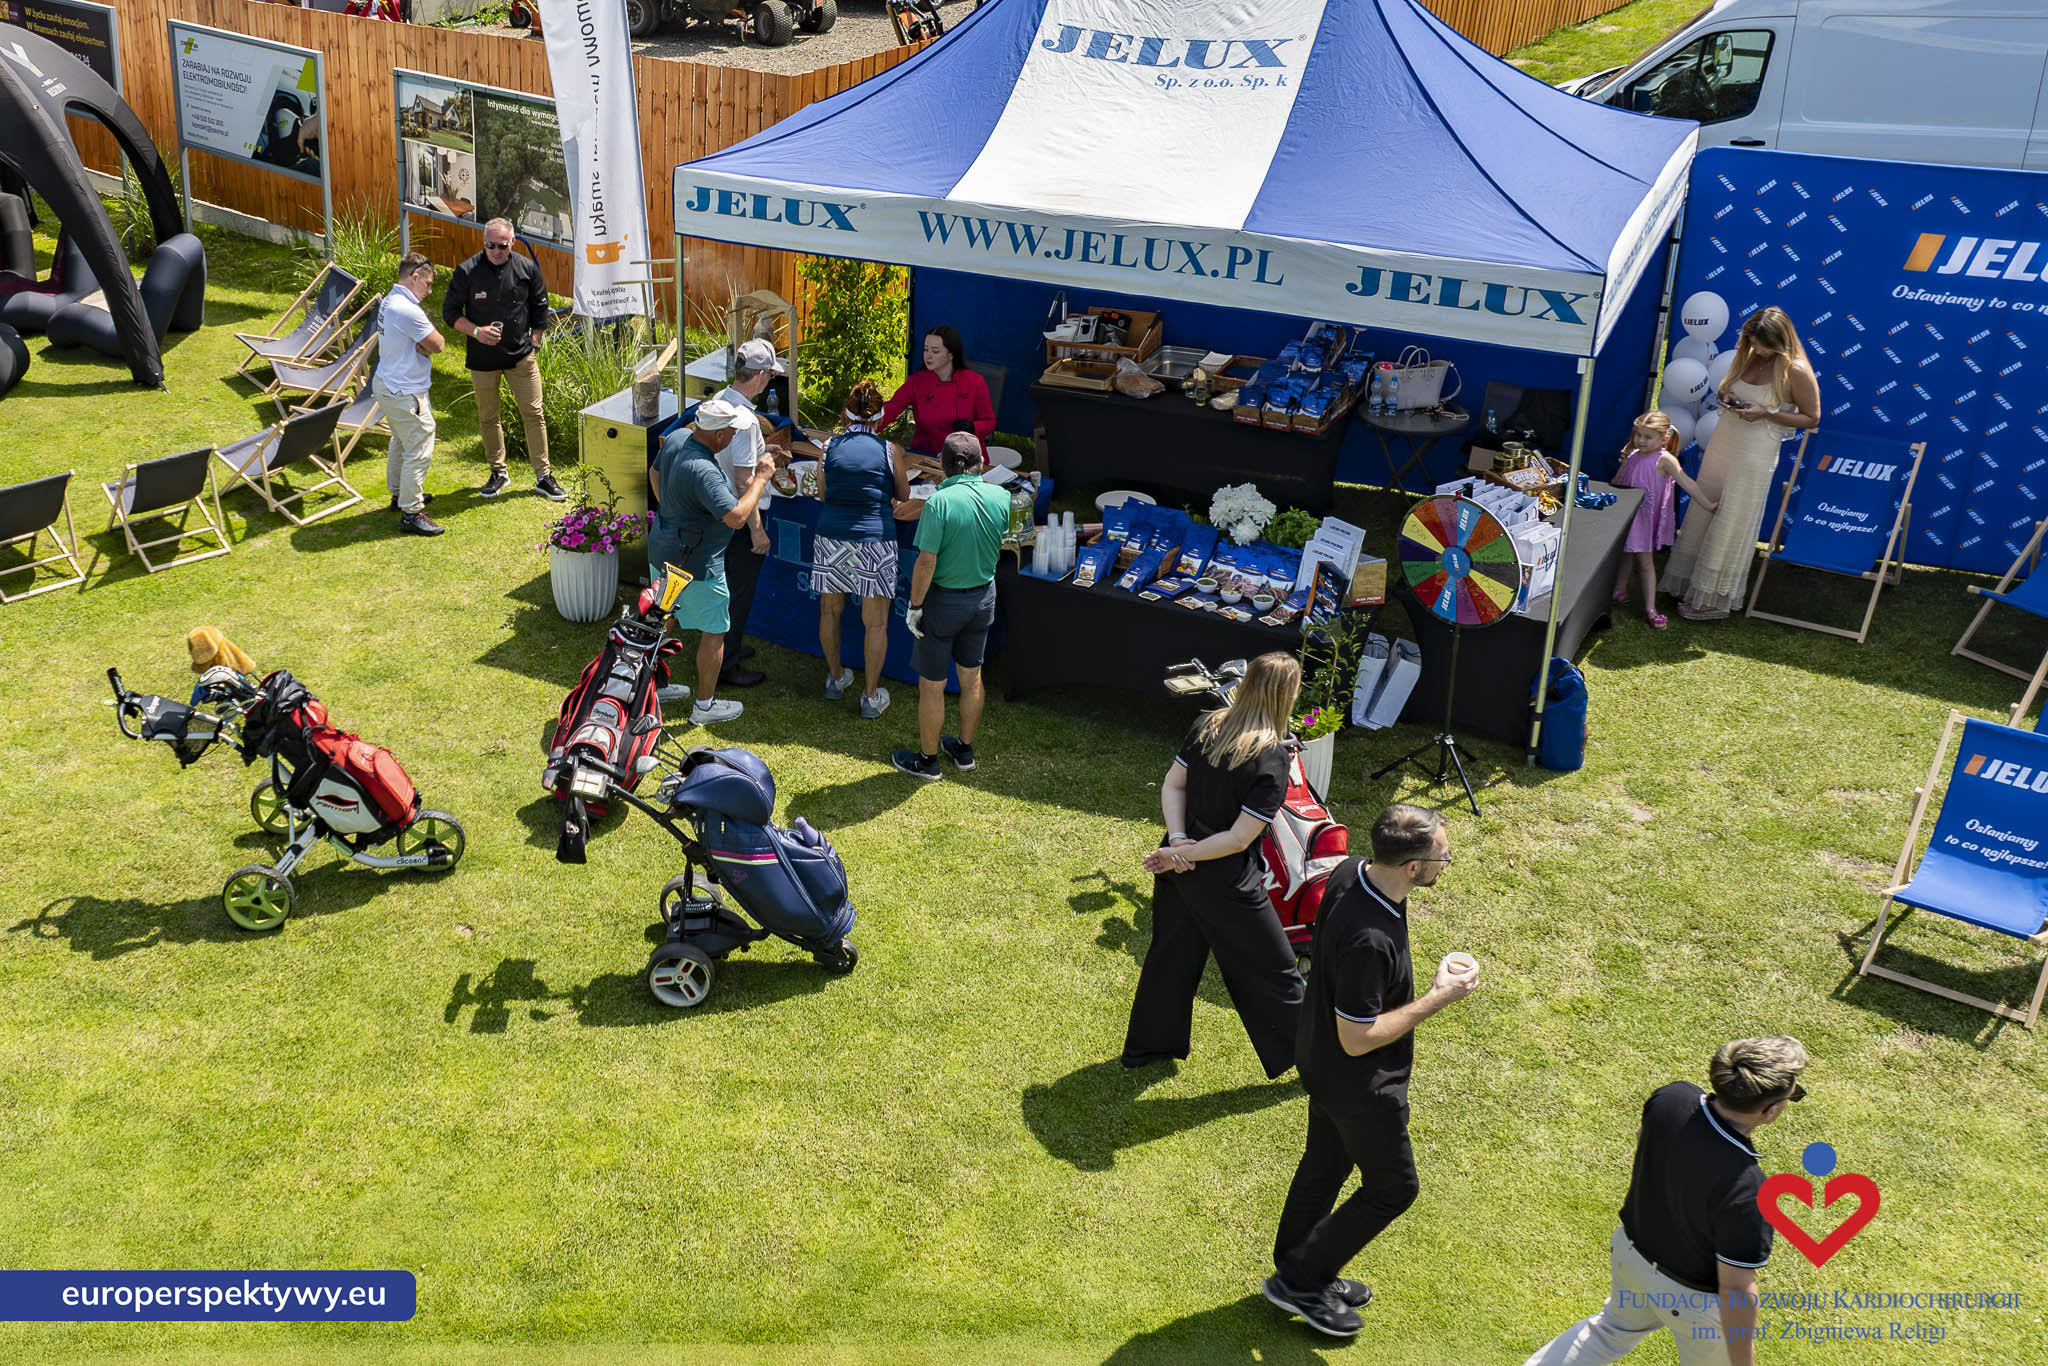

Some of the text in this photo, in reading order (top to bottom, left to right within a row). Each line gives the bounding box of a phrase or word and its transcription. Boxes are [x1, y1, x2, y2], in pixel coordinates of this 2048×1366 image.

[182, 59, 252, 84] ZARABIAJ NA ROZWOJU
[1188, 78, 1198, 88] z
[1276, 74, 1288, 87] k
[487, 98, 519, 113] Intymność
[520, 106, 531, 116] dla
[1720, 177, 1736, 191] JELUX
[1759, 179, 1777, 194] JELUX
[1794, 184, 1810, 199] JELUX
[1835, 186, 1853, 201] JELUX
[1870, 190, 1888, 206] JELUX
[1914, 194, 1934, 210] JELUX
[1952, 199, 1970, 214] JELUX
[1999, 200, 2019, 215] JELUX
[1717, 204, 1733, 218] JELUX
[1755, 210, 1771, 224] JELUX
[1790, 212, 1807, 226] JELUX
[1830, 215, 1847, 232] JELUX
[917, 210, 1286, 287] WWW.JELUX.PL
[1712, 240, 1727, 253] JELUX
[1751, 242, 1768, 255] JELUX
[1784, 248, 1800, 261] JELUX
[1825, 250, 1842, 264] JELUX
[1936, 236, 2048, 284] JEL
[1708, 265, 1726, 279] JELUX
[1746, 272, 1762, 286] JELUX
[1780, 273, 1798, 287] JELUX
[1820, 280, 1836, 294] JELUX
[1892, 284, 1985, 312] Osłaniamy
[1988, 297, 2008, 309] to
[2011, 302, 2035, 312] co
[1687, 318, 1709, 326] JELUX
[1815, 312, 1832, 324] JELUX
[1849, 317, 1865, 331] JELUX
[1891, 321, 1909, 334] JELUX
[1927, 324, 1944, 340] JELUX
[1971, 329, 1990, 343] JELUX
[2009, 335, 2026, 349] JELUX
[1810, 339, 1826, 354] JELUX
[1842, 344, 1861, 357] JELUX
[1886, 350, 1902, 364] JELUX
[1919, 353, 1940, 366] JELUX
[1964, 359, 1982, 373] JELUX
[2003, 362, 2022, 375] JELUX
[1838, 375, 1854, 390] JELUX
[1880, 381, 1897, 393] JELUX
[1915, 384, 1931, 400] JELUX
[1957, 390, 1977, 404] JELUX
[1834, 402, 1850, 414] JELUX
[1995, 396, 2012, 410] JELUX
[1874, 409, 1890, 422] JELUX
[1909, 412, 1927, 424] JELUX
[1952, 419, 1968, 432] JELUX
[1989, 422, 2008, 434] JELUX
[1828, 457, 1898, 482] JELUX
[1817, 502, 1869, 522] Osłaniamy
[1459, 508, 1470, 531] JELUX
[1803, 514, 1879, 533] to co najlepsze!
[1441, 589, 1452, 612] JELUX
[1965, 818, 2040, 851] Osłaniamy
[1944, 834, 1960, 844] to
[1961, 841, 1979, 851] co
